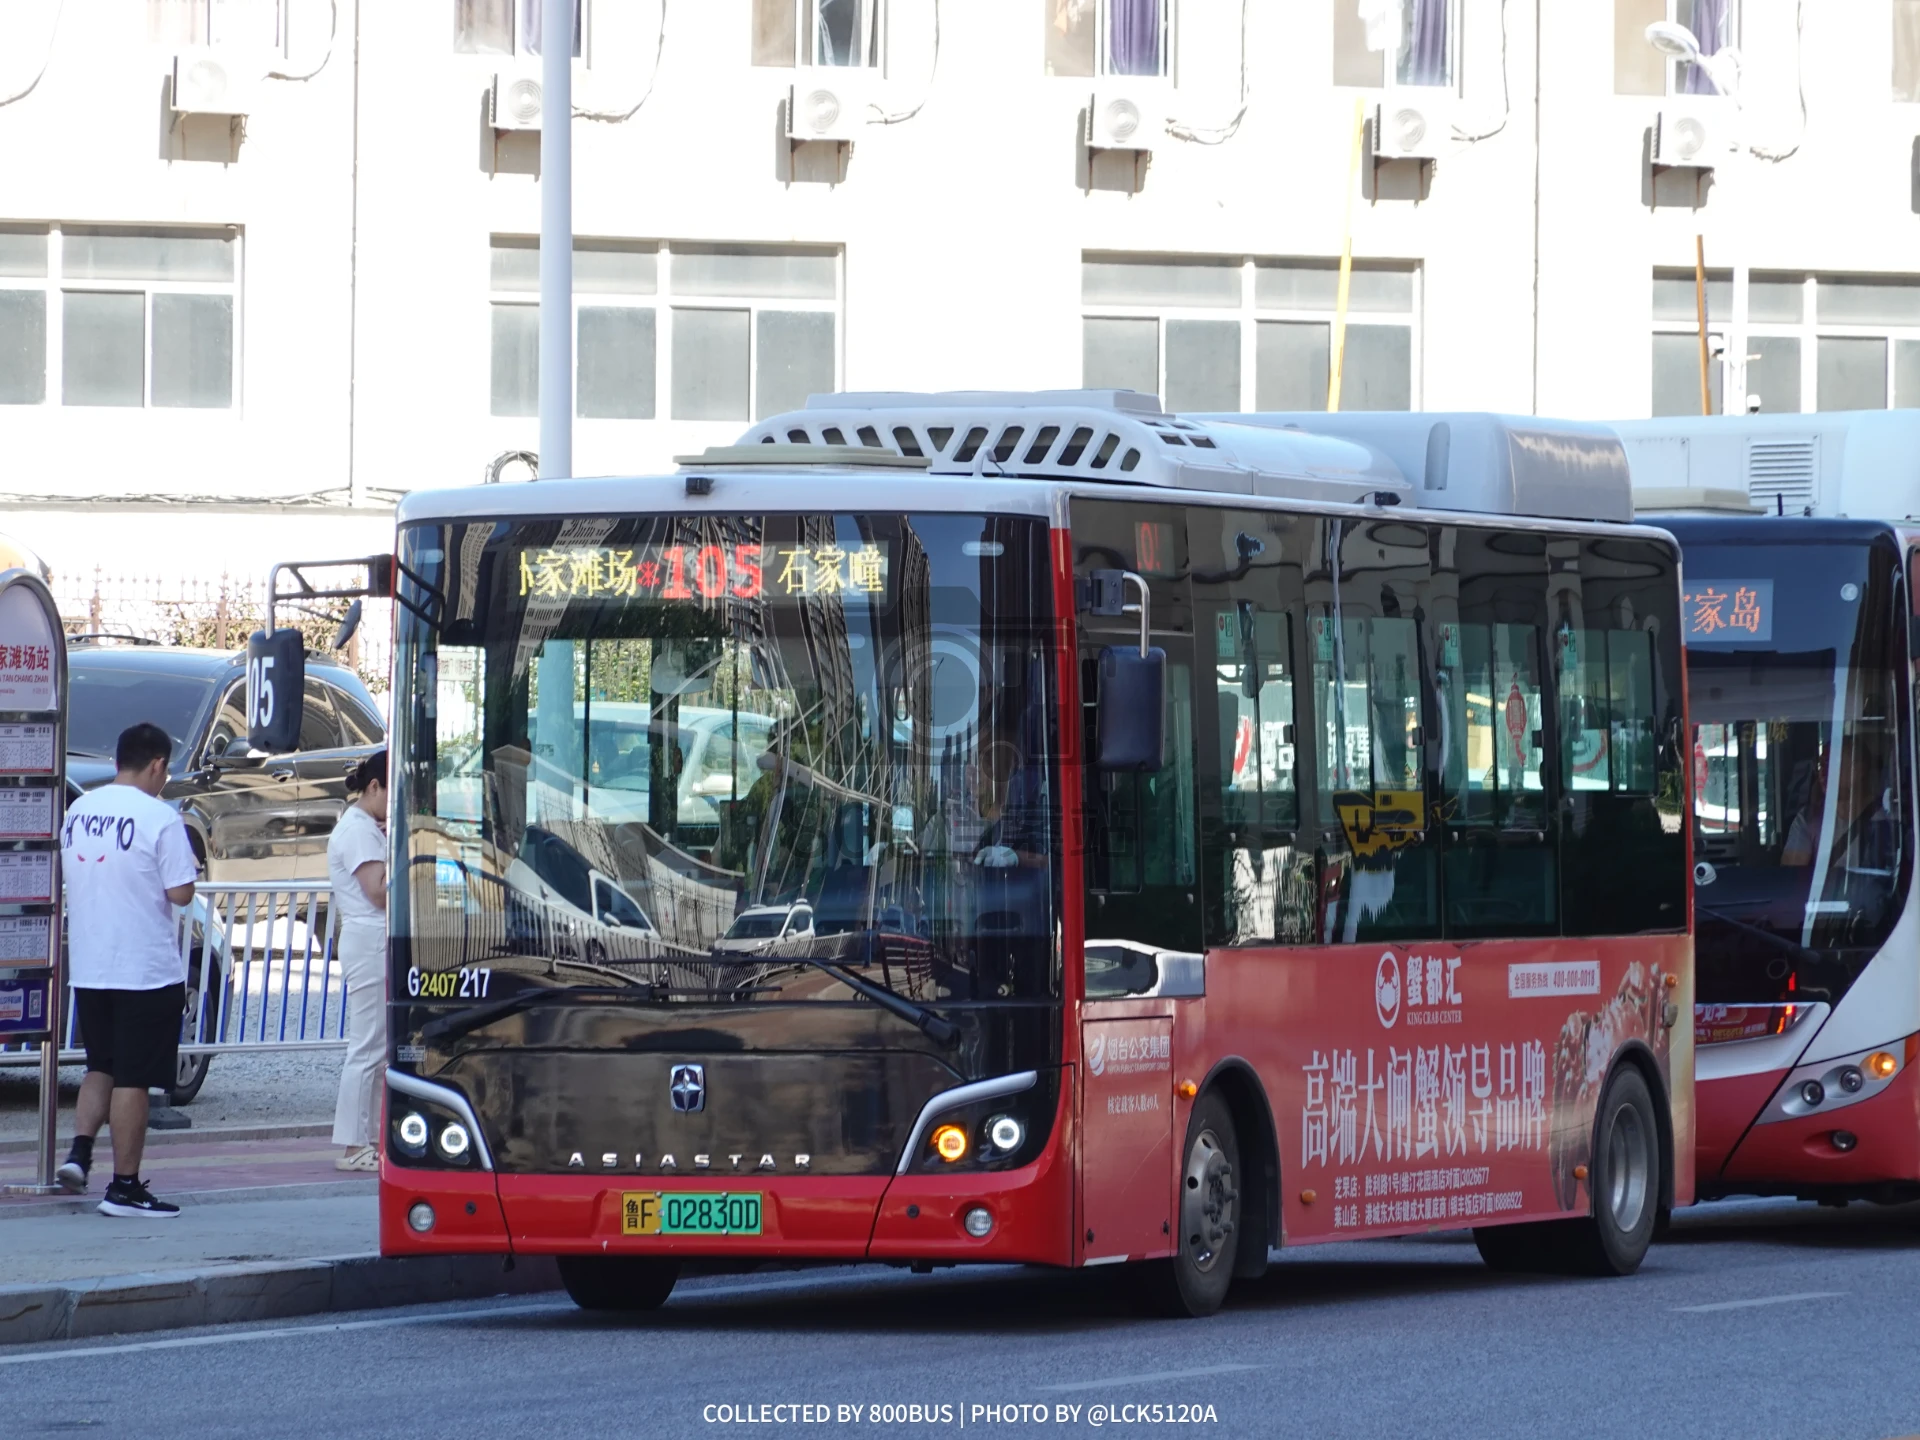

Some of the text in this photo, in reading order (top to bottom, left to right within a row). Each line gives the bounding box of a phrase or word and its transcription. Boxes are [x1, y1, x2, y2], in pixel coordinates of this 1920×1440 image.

[662, 546, 763, 599] 105
[1684, 587, 1760, 634] 家岛
[1407, 956, 1462, 1006] 蟹都汇
[1514, 972, 1549, 990] 全国服务热线
[1407, 1010, 1462, 1025] KING CRAB CENTER
[1107, 1036, 1170, 1061] 烟台公交集团
[1302, 1039, 1547, 1169] 高端大闸蟹领导品牌
[568, 1152, 811, 1168] ASIASTAR
[626, 1199, 759, 1229] 鲁F 02830D
